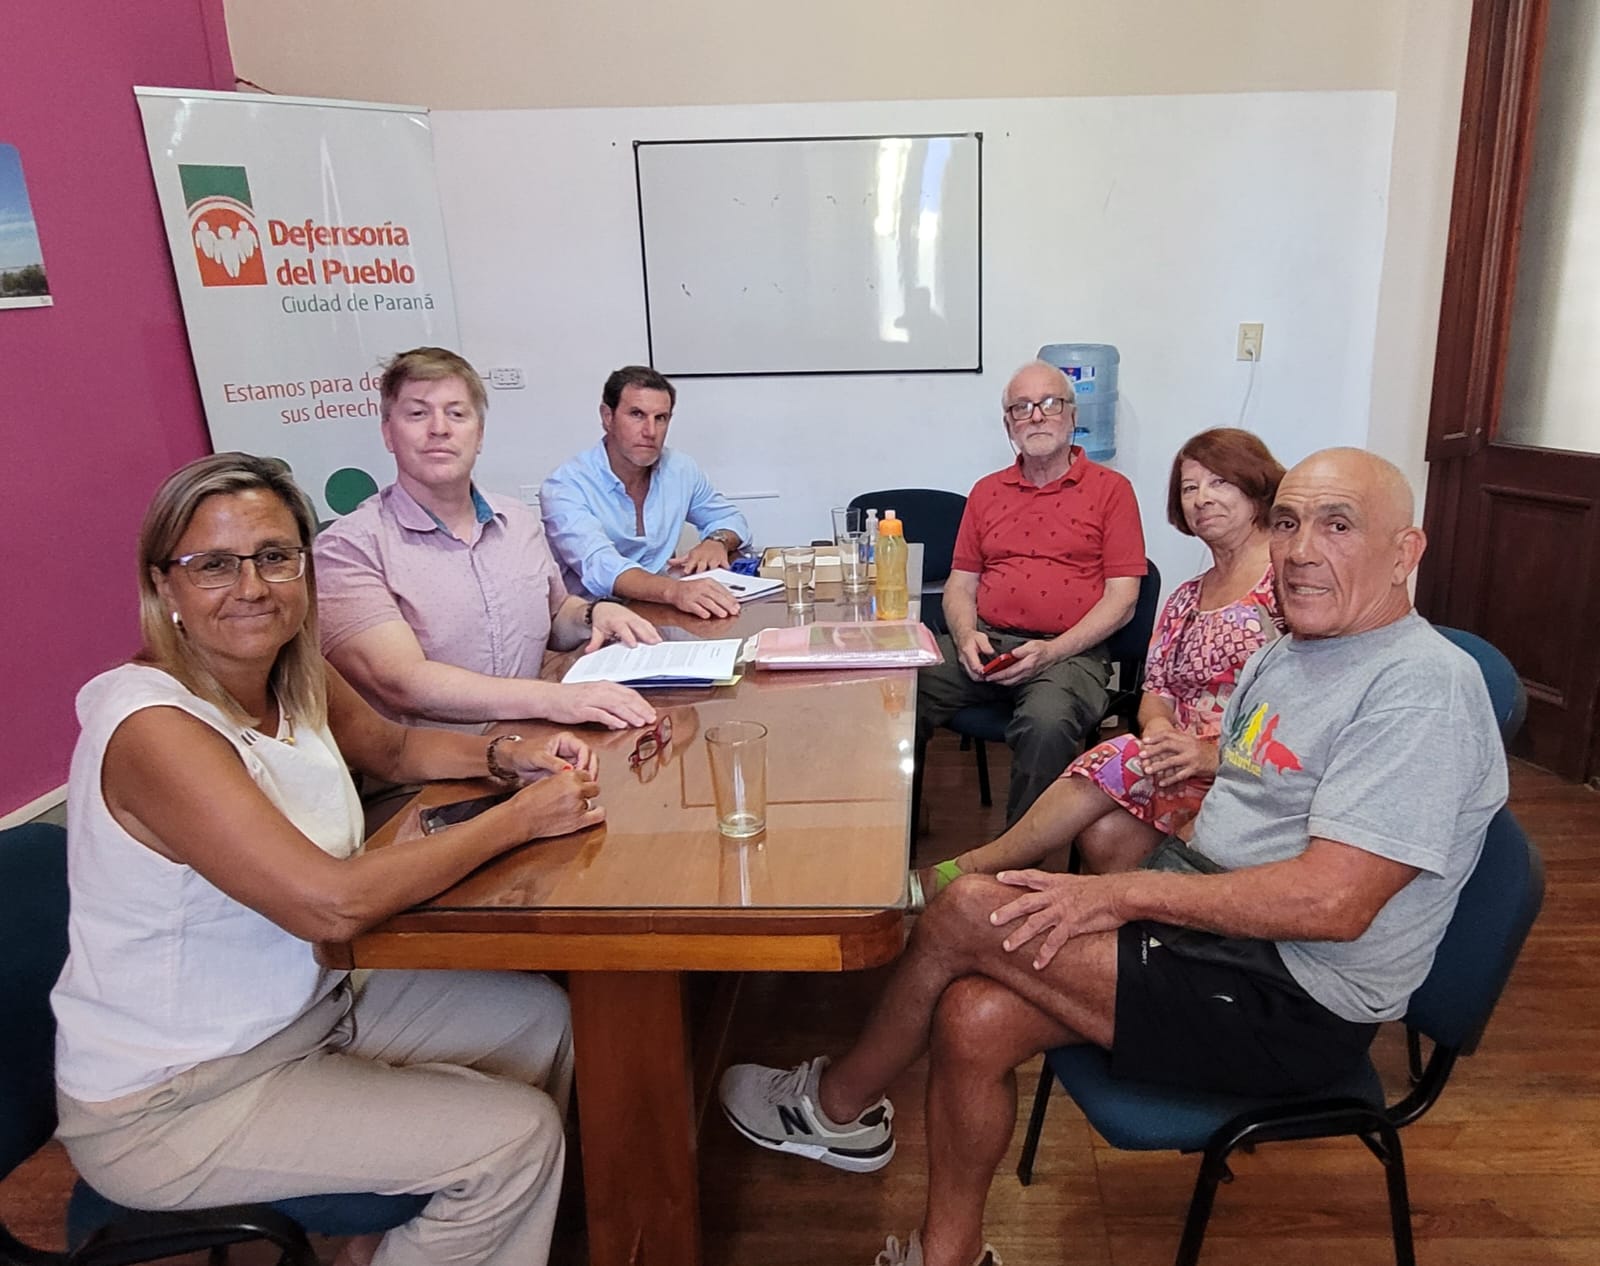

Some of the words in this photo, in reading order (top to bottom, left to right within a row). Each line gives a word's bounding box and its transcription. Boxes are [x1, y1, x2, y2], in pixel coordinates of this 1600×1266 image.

[268, 218, 410, 253] Defensoría
[276, 258, 317, 285] del
[322, 257, 416, 285] Pueblo
[281, 293, 342, 313] Ciudad
[347, 293, 369, 312] de
[374, 293, 435, 312] Paraná
[224, 380, 306, 403] Estamos
[310, 377, 354, 399] para
[359, 371, 381, 392] de
[280, 407, 310, 424] sus
[314, 397, 380, 420] derech
